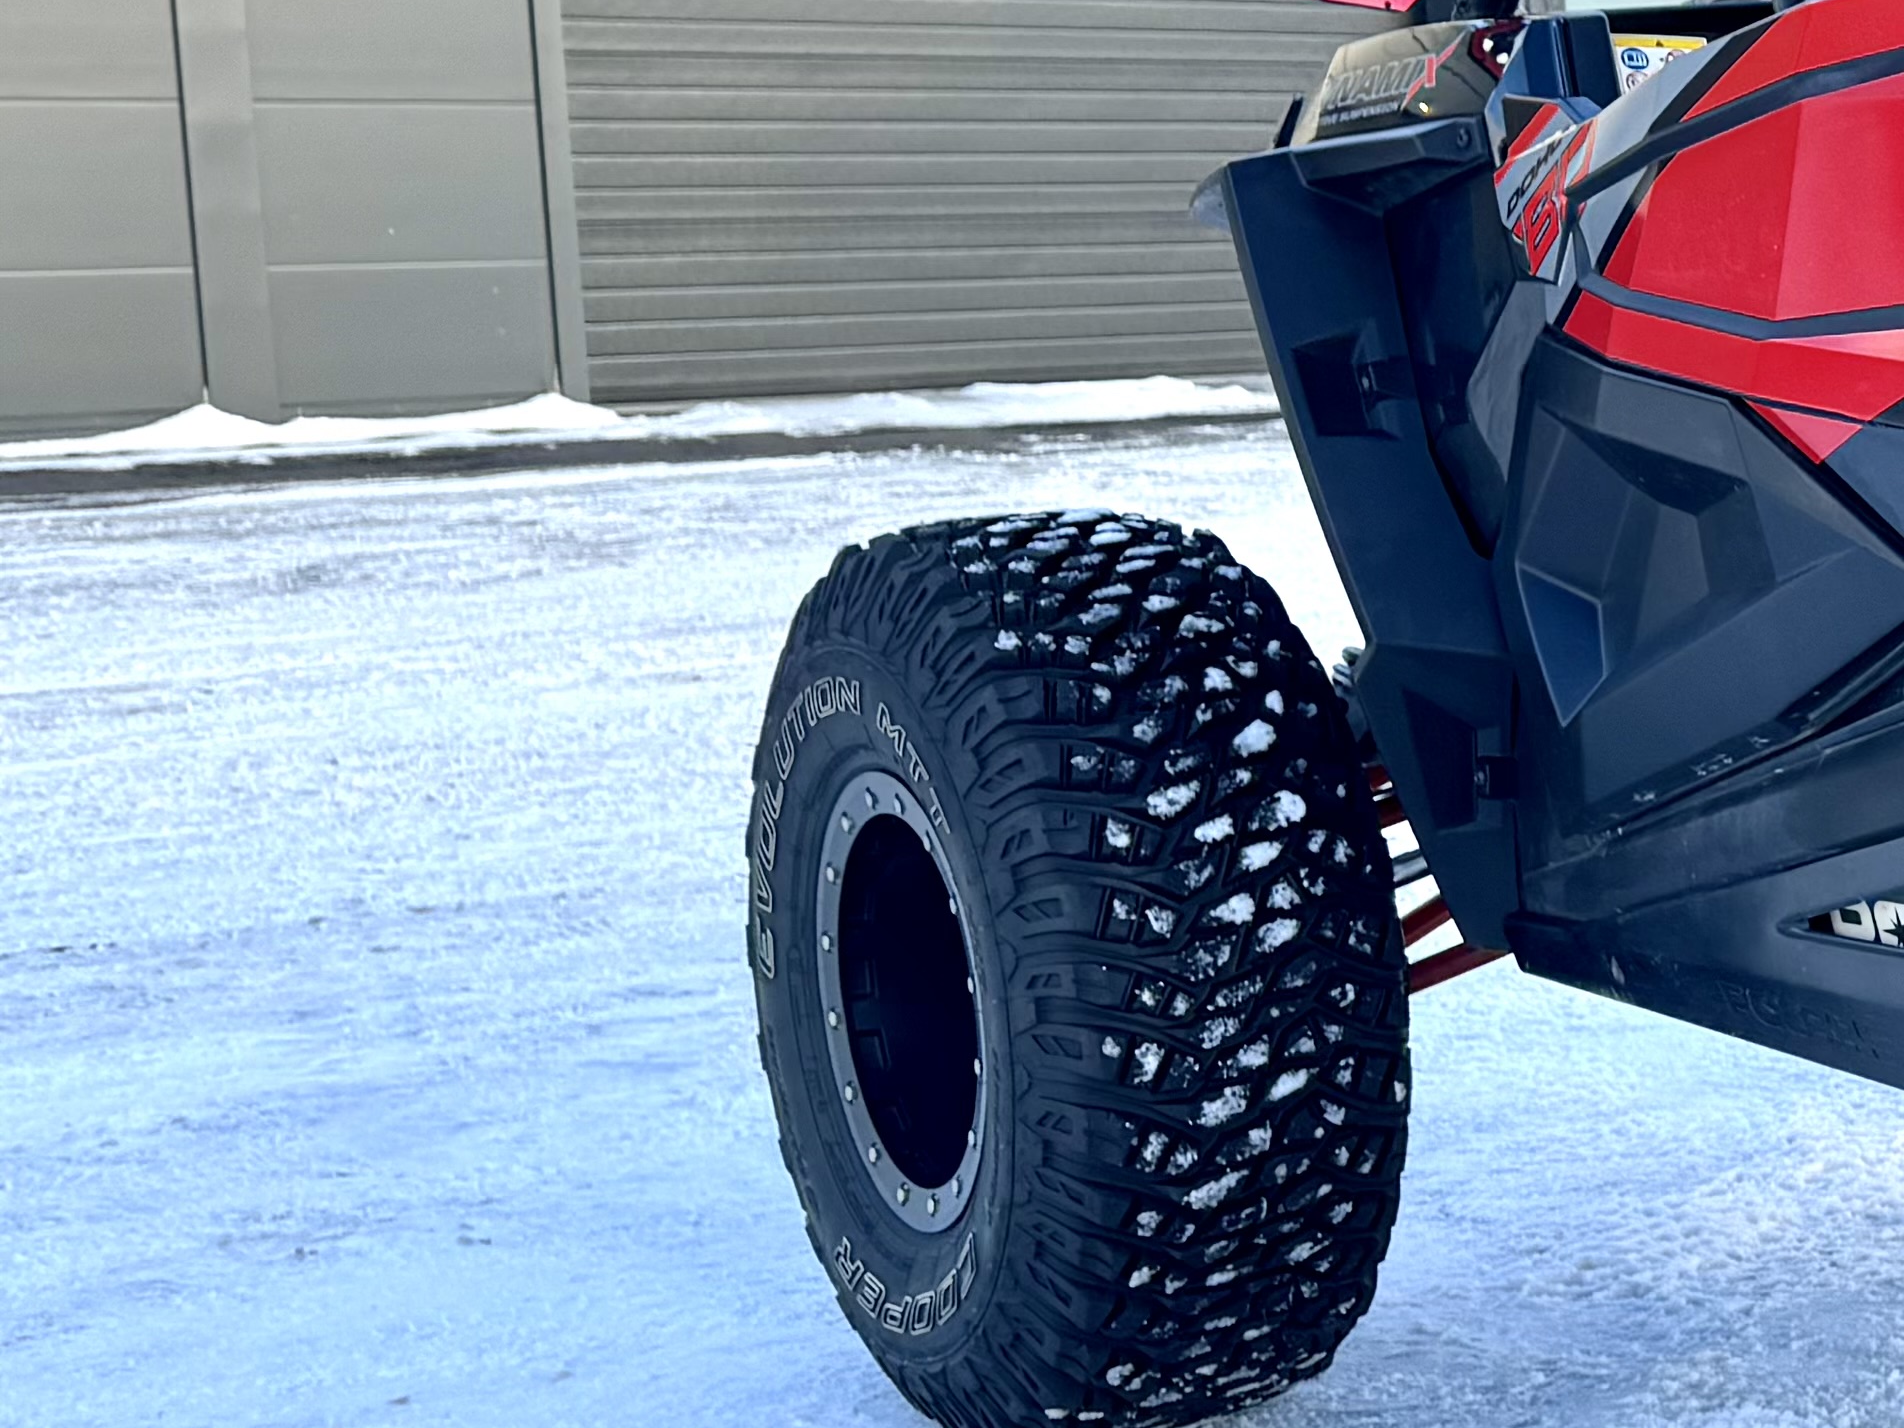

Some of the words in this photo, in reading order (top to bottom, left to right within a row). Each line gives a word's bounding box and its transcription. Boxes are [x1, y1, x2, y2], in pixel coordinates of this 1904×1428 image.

[752, 677, 862, 979] EVOLUTION
[877, 702, 950, 836] MTT
[834, 1233, 974, 1336] COOPER
